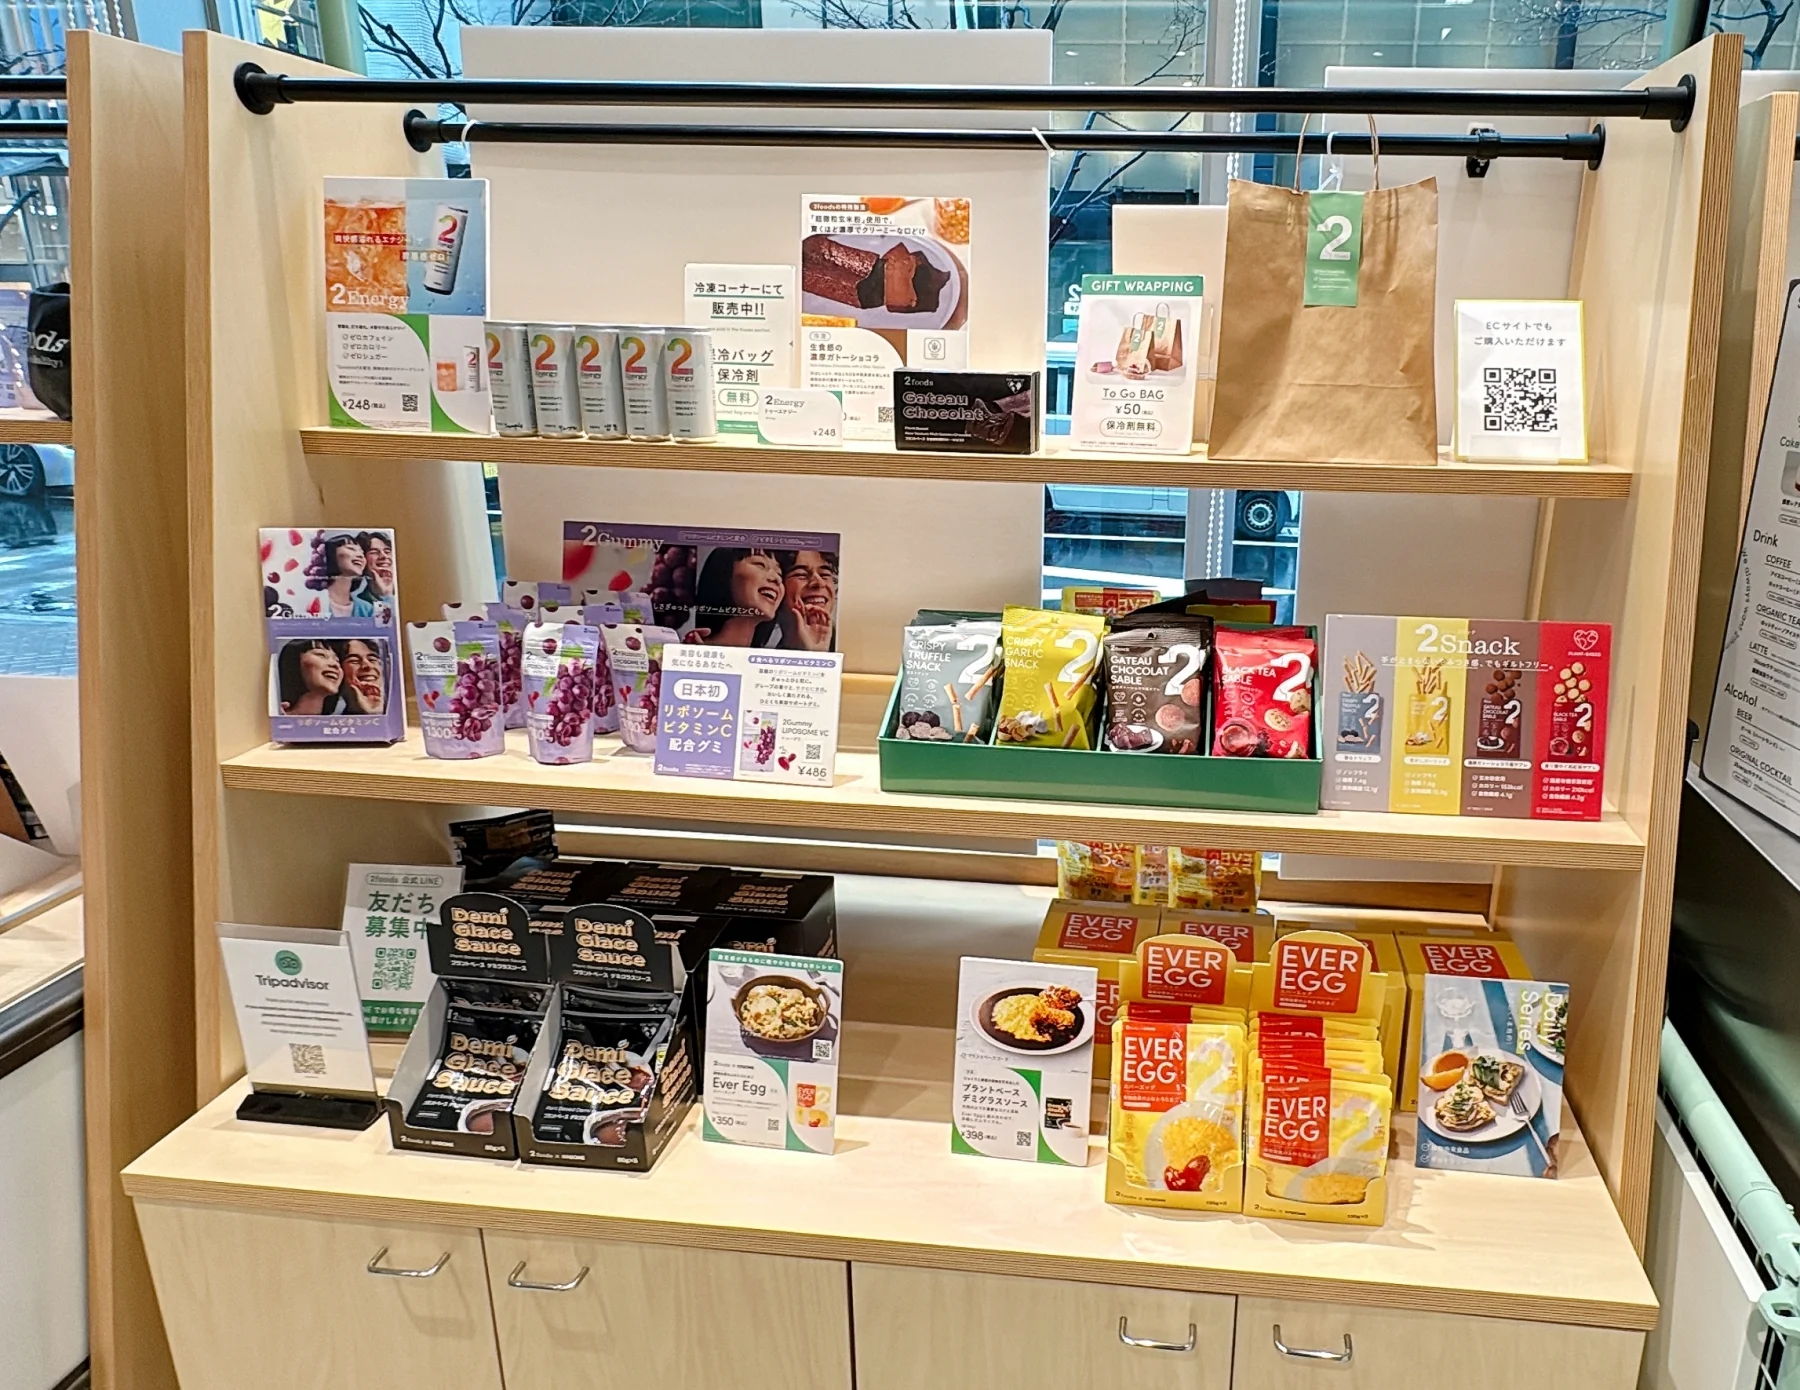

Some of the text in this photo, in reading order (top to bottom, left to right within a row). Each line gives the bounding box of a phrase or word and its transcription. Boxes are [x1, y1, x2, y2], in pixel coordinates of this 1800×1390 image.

[439, 215, 459, 245] 2
[1316, 215, 1353, 260] 2
[694, 282, 783, 295] 冷凍コーナーにて
[1091, 280, 1195, 293] GIFT WRAPPING
[712, 302, 765, 316] 販売中!!
[1486, 321, 1552, 331] ECサイトでも
[1474, 337, 1566, 347] ご購入いただけます
[530, 334, 558, 370] 2
[576, 336, 602, 372] 2
[621, 336, 647, 373] 2
[667, 337, 694, 374] 2
[810, 353, 880, 362] 濃厚ガトーショコラ
[717, 368, 759, 382] 保冷剤
[902, 391, 969, 406] Gateau
[1103, 388, 1164, 400] To Go BAG
[342, 399, 371, 410] ¥248
[1115, 403, 1141, 415] ¥50
[902, 406, 984, 421] Chocolat
[813, 428, 836, 436] ¥248
[1753, 529, 1778, 547] Drink
[1765, 554, 1792, 569] COFFEE
[1756, 603, 1788, 622] ORGANIC
[909, 640, 946, 650] CRISPY
[1415, 624, 1521, 656] 2Snack
[1749, 641, 1768, 655] LATTE
[907, 650, 951, 662] TRUFFLE
[1005, 647, 1044, 658] GARLIC
[906, 660, 941, 671] SNACK
[1005, 657, 1039, 668] SNACK
[1110, 656, 1152, 666] GATEAU
[1110, 665, 1169, 676] CHOCOLAT
[1257, 667, 1276, 678] TEA
[1269, 652, 1311, 702] 2
[1110, 675, 1142, 685] SABLE
[1222, 675, 1253, 686] SABLE
[682, 683, 721, 698] 日本初
[1724, 683, 1758, 707] Alcohol
[664, 705, 734, 721] リポソーム
[1736, 707, 1753, 721] BEER
[664, 721, 732, 738] ビタミンC
[669, 738, 722, 754] 配合グミ
[798, 766, 827, 777] ¥486
[1730, 744, 1793, 786] ORIGINAL COCKTAIL
[367, 891, 435, 914] 友だち
[451, 907, 508, 925] Demi
[1069, 914, 1133, 930] EVER
[365, 916, 428, 939] 募集中
[452, 922, 513, 940] Glace
[574, 918, 634, 937] Demi
[1066, 926, 1123, 941] EGG
[1184, 923, 1249, 938] EVER
[454, 938, 522, 955] Sauce
[576, 933, 639, 951] Glace
[577, 948, 646, 967] Sauce
[1147, 946, 1222, 971] EVER
[1282, 945, 1359, 972] EVER
[1425, 946, 1496, 961] EVER
[1431, 958, 1492, 974] EGG
[255, 975, 330, 991] Tripadvisor
[1147, 967, 1212, 988] EGG
[1280, 968, 1347, 994] EGG
[1519, 990, 1539, 1051] Series
[1538, 992, 1563, 1044] Daily
[451, 1031, 518, 1058] Demi
[565, 1039, 628, 1064] Demi
[1124, 1036, 1184, 1061] EVER
[1123, 1060, 1178, 1084] EGG
[432, 1070, 516, 1095] Sauce
[713, 1077, 766, 1097] Ever Egg
[962, 1083, 1020, 1096] プラントベース
[549, 1081, 635, 1106] Sauce
[962, 1094, 1028, 1108] デミグラスソース
[1265, 1096, 1327, 1120] EVER
[1264, 1117, 1320, 1142] EGG
